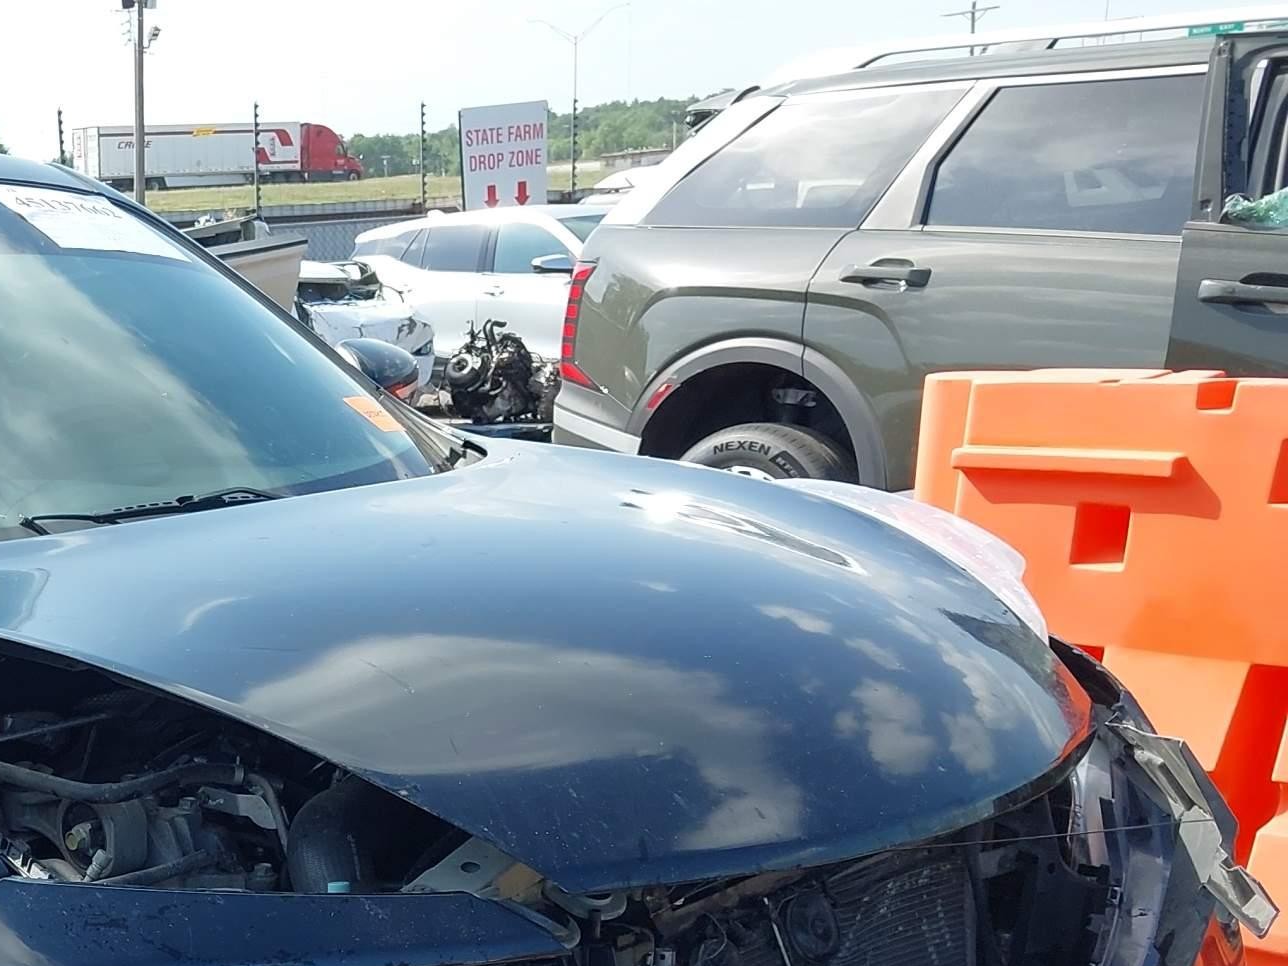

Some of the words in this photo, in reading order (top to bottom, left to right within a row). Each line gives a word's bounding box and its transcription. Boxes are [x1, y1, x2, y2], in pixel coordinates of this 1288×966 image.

[117, 141, 152, 149] CRE
[465, 127, 504, 147] STATE
[508, 123, 544, 142] FARM
[469, 152, 504, 172] DROP
[509, 148, 542, 168] ZONE
[714, 440, 771, 456] NEXEN
